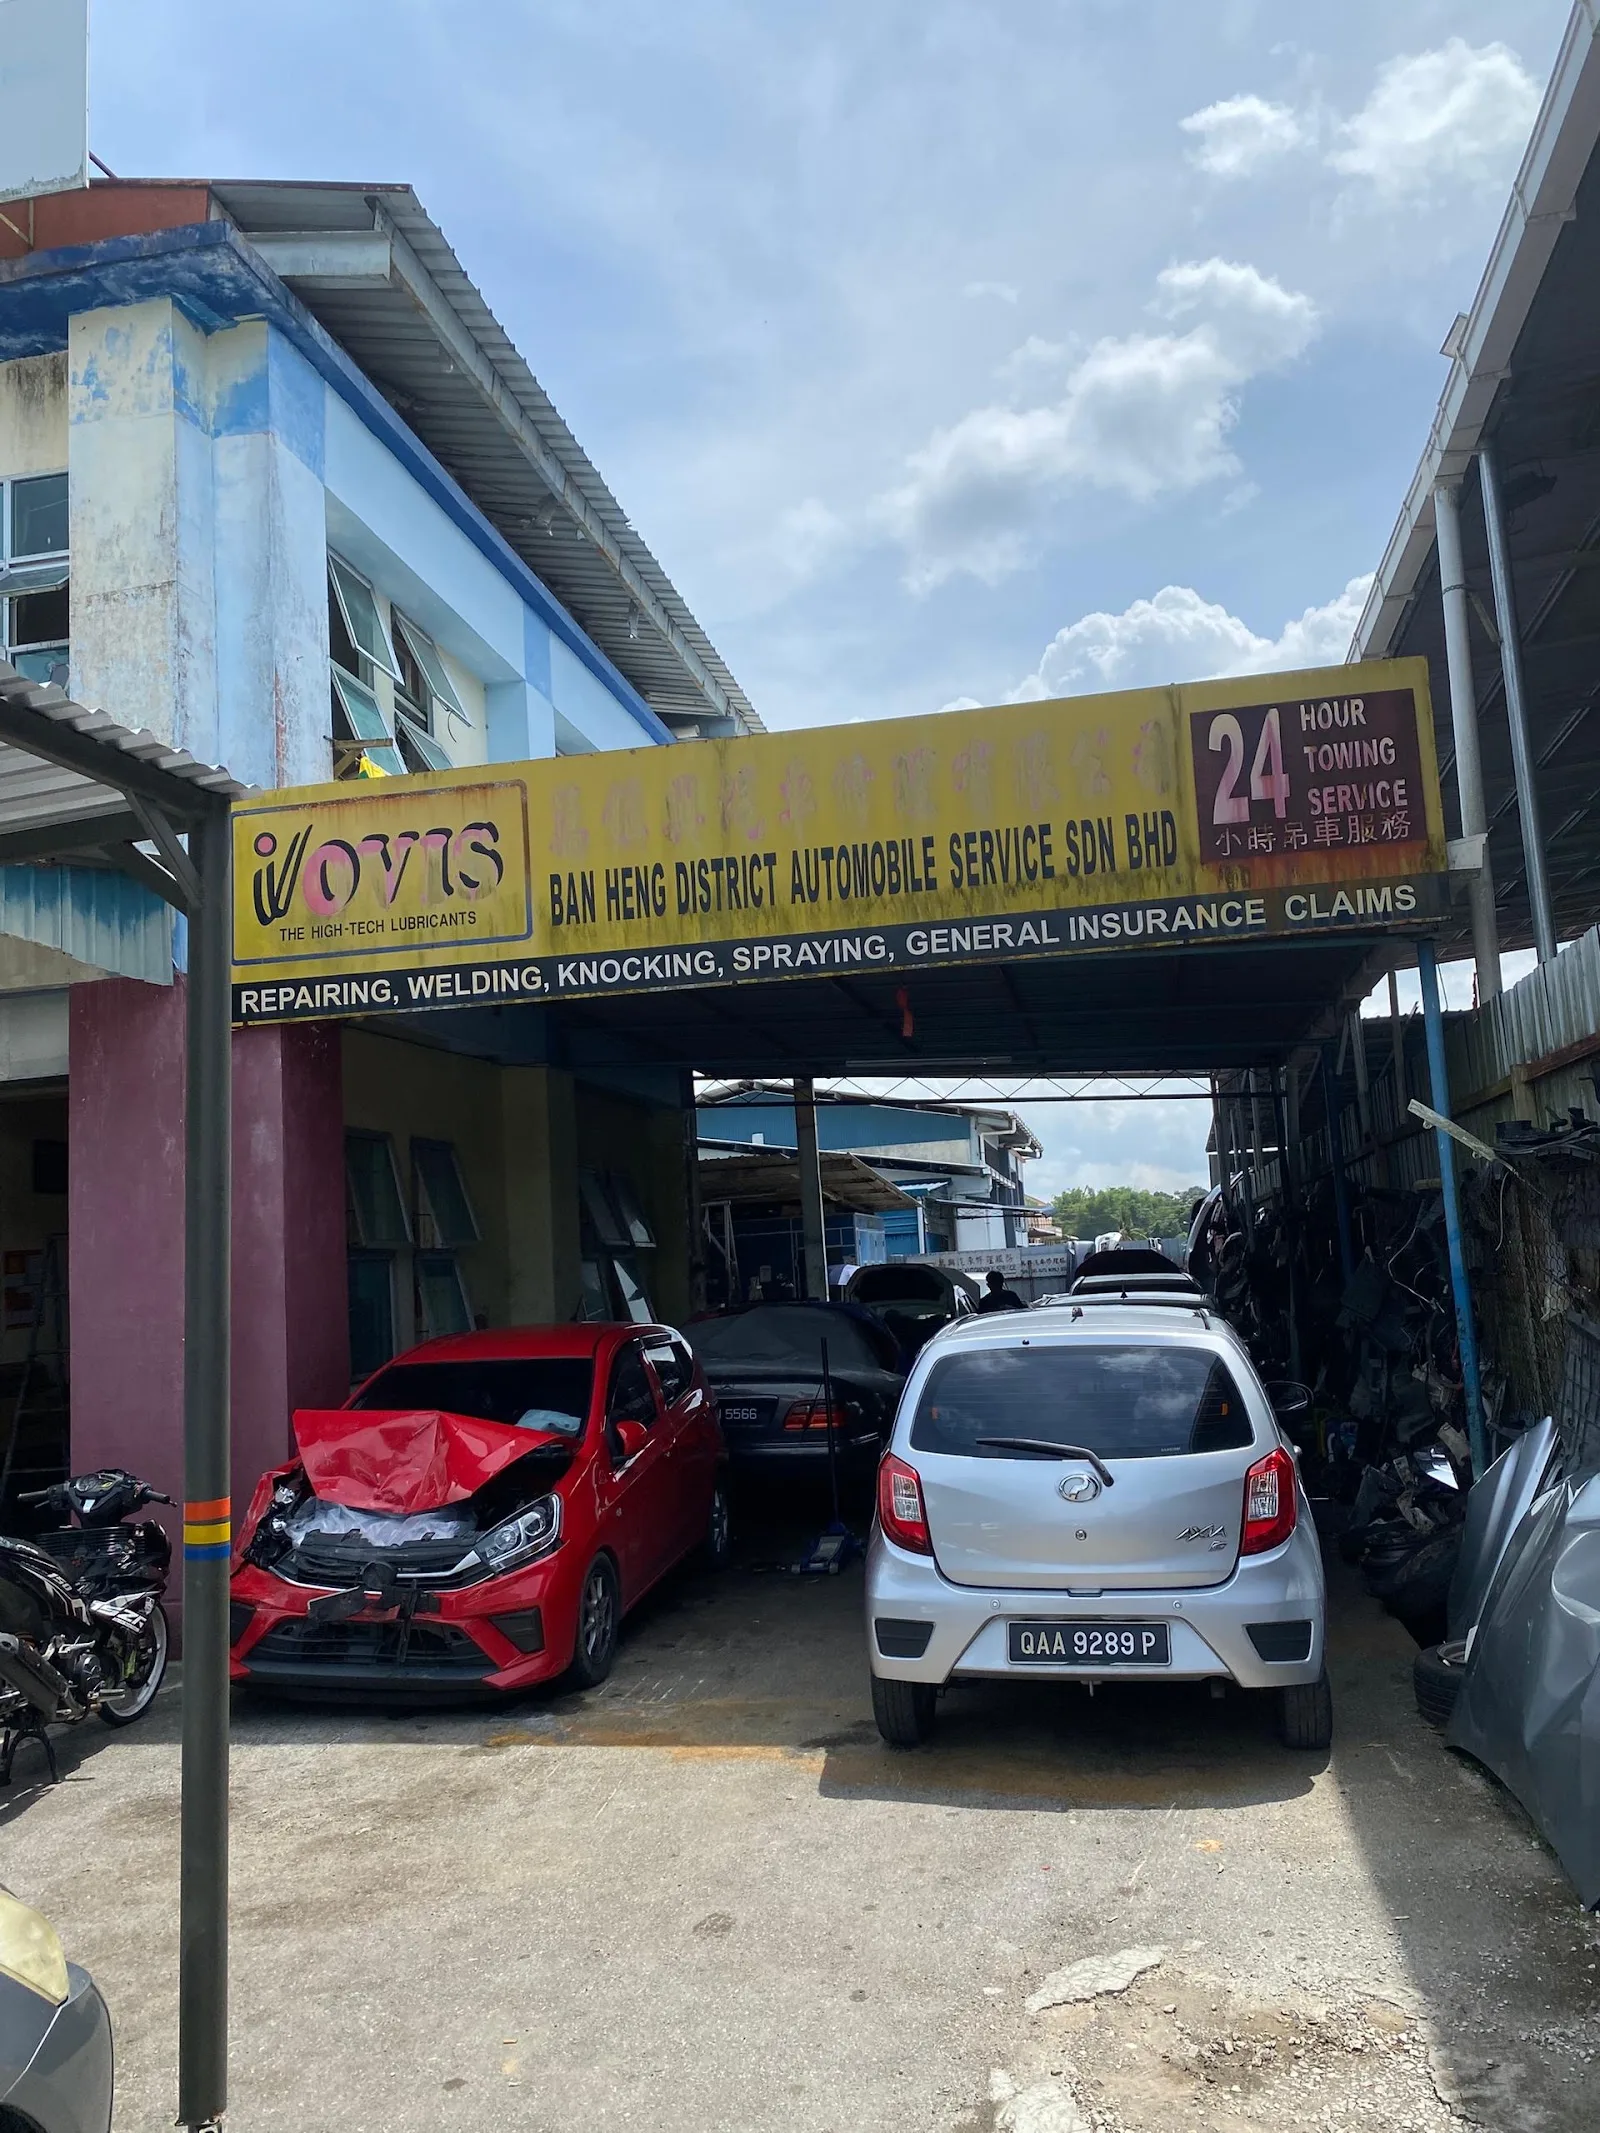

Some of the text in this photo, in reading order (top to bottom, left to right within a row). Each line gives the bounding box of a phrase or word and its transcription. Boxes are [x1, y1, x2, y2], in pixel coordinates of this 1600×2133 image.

[1300, 698, 1367, 732] HOUR
[1208, 707, 1290, 825] 24
[1303, 737, 1396, 773] TOWING
[1307, 778, 1408, 816] SERVICE
[1215, 810, 1411, 856] 小時吊車服務
[550, 810, 1177, 926] BAN HENG DISTRICT AUTOMOBILE SERVICE SDN BHD
[280, 911, 477, 942] THE HIGH-TECH LUBRICANTS
[240, 884, 1416, 1014] REPAIRING, WELDING, KNOCKING, SPRAYING, GENERAL INSURANCE CLAIMS
[725, 1408, 757, 1420] 5566
[47, 1572, 73, 1591] 150
[1020, 1631, 1156, 1656] QAA 9289 P
